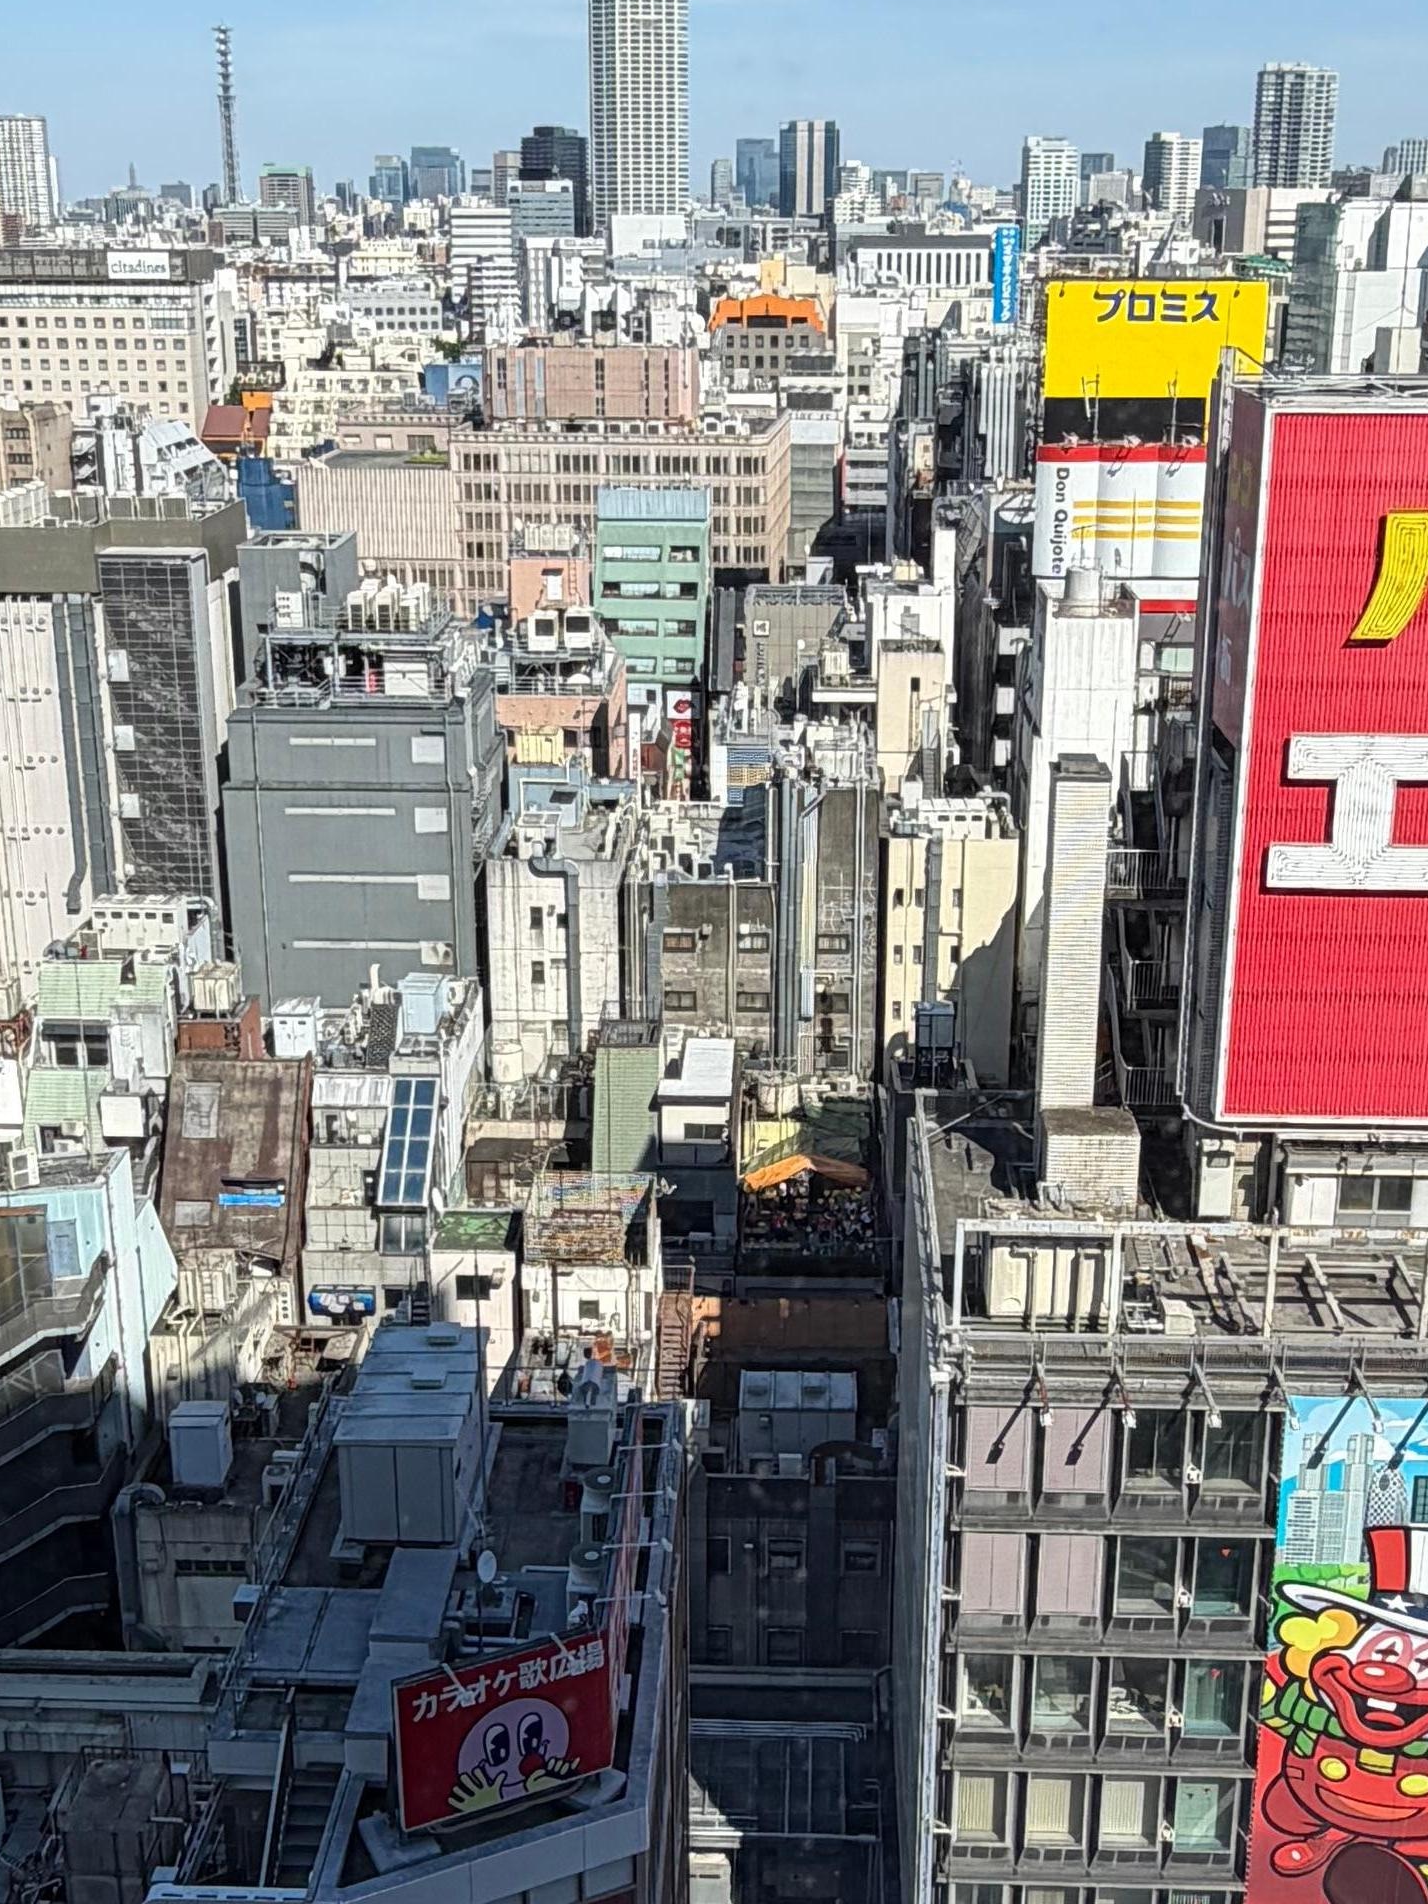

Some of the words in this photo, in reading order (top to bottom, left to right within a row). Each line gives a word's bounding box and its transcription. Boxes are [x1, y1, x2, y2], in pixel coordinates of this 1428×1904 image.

[110, 259, 167, 275] citadines
[1094, 291, 1220, 324] プロミス
[1052, 465, 1072, 505] Don
[1049, 507, 1070, 576] Quijote
[412, 1639, 605, 1723] カラオケ歌広場
